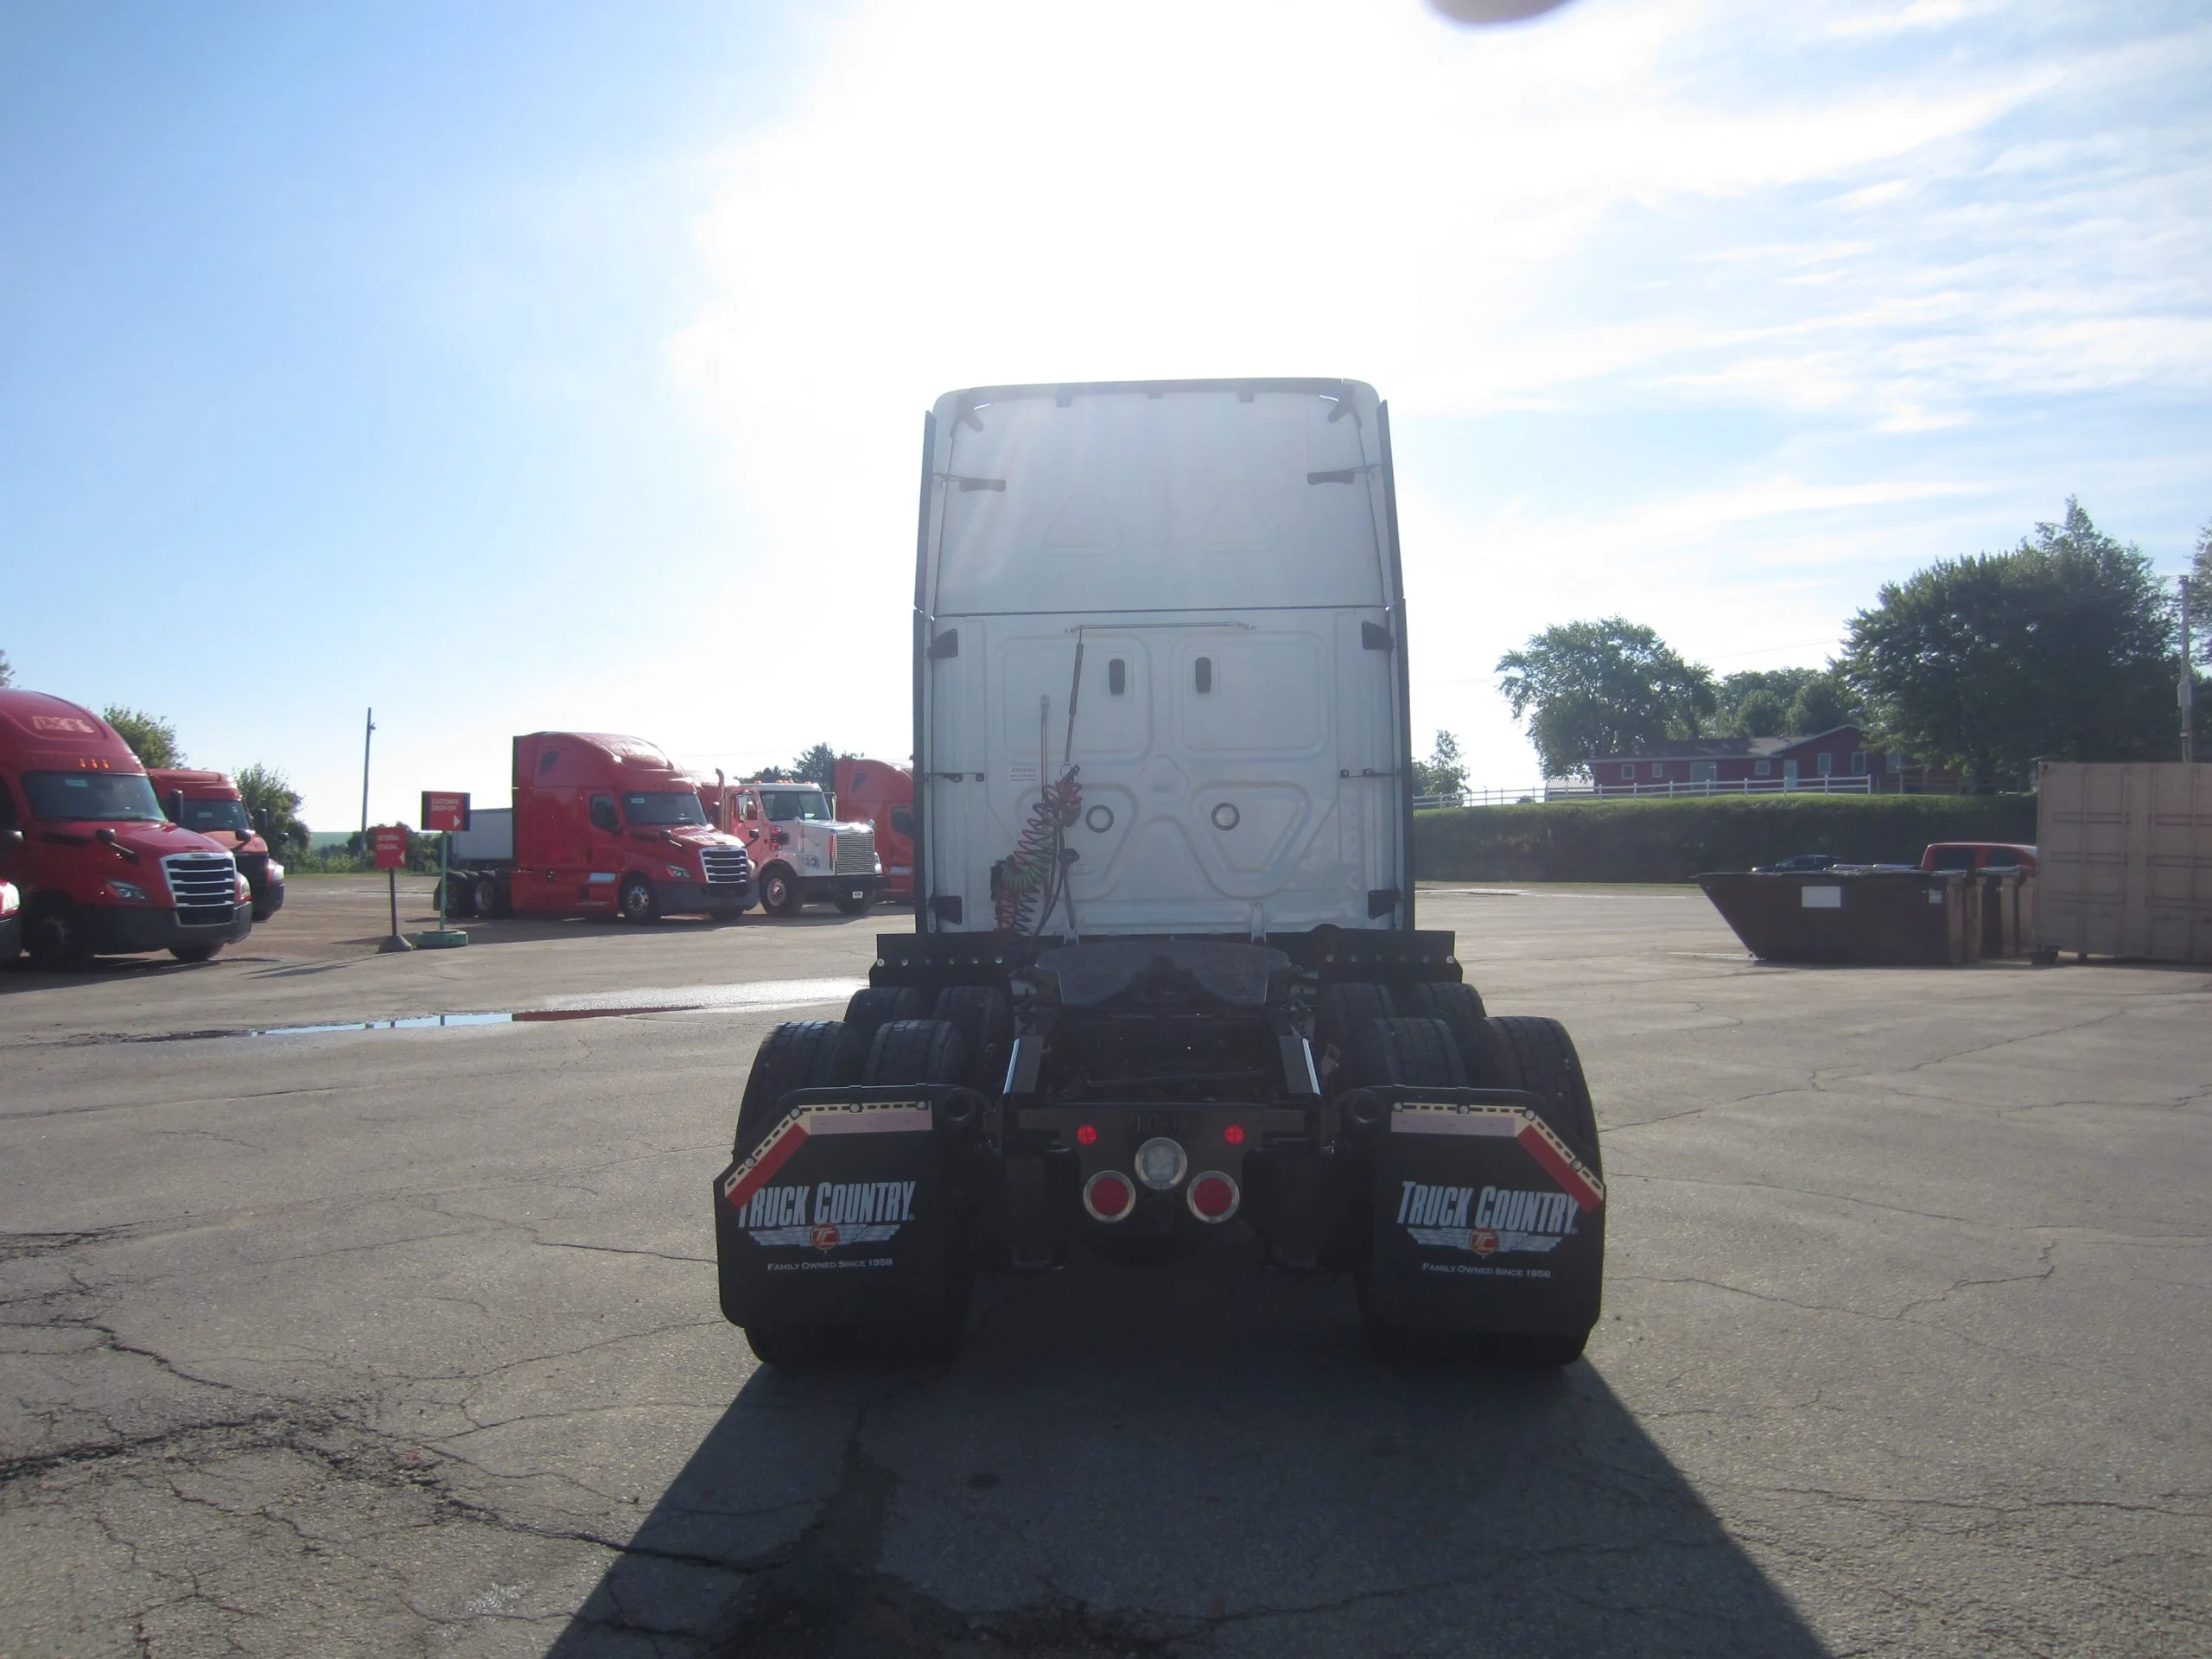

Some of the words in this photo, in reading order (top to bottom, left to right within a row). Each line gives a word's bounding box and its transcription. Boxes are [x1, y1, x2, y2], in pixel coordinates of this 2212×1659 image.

[815, 1181, 916, 1224] COUNTRY
[1397, 1181, 1474, 1227] TRUCK
[1474, 1185, 1579, 1234] COUNTRY
[767, 1262, 800, 1271] FAMILY
[801, 1261, 836, 1269] OWNED
[838, 1260, 867, 1268] SINCE
[868, 1258, 893, 1267] 1958
[1422, 1262, 1457, 1273] FAMILY
[1458, 1265, 1493, 1274] OWNED
[1495, 1267, 1523, 1277] SINCE
[1526, 1268, 1551, 1278] 1958
